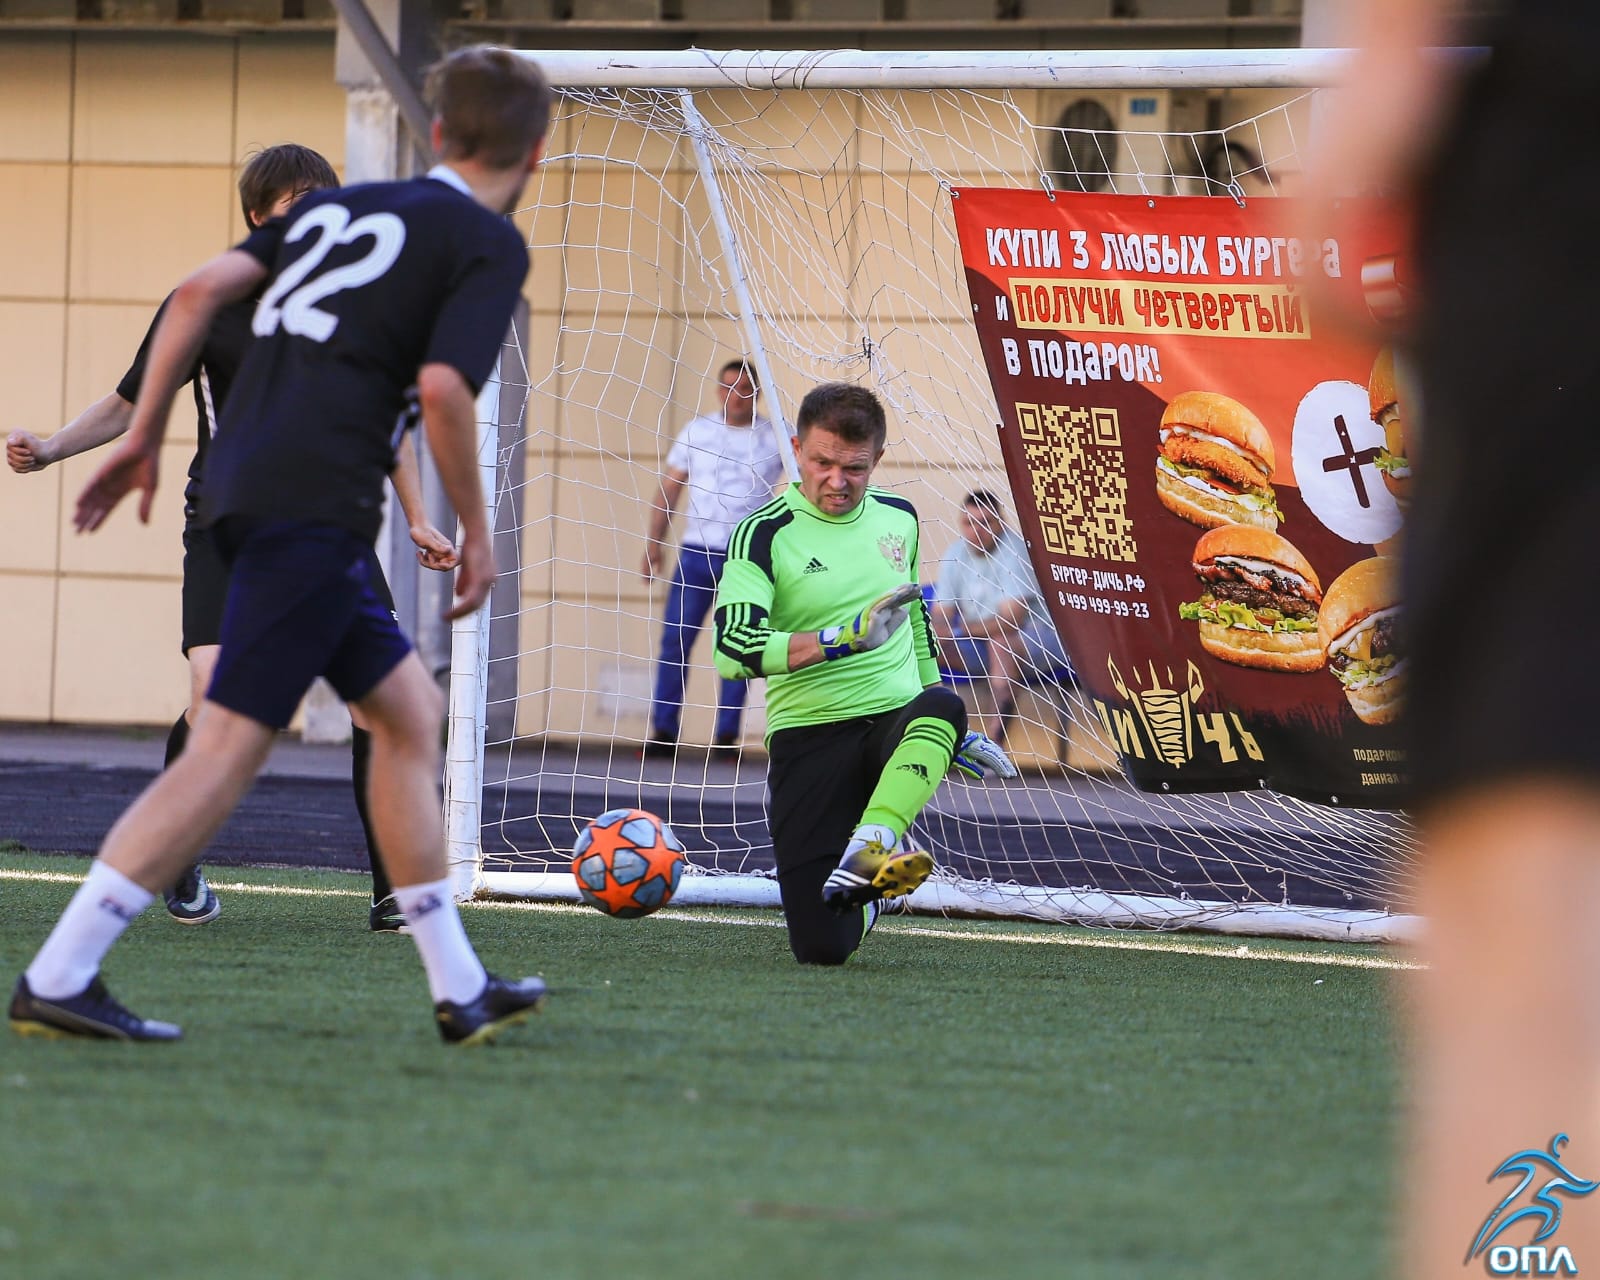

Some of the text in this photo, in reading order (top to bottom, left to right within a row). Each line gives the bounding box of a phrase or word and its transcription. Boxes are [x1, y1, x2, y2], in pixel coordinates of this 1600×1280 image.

[252, 203, 406, 343] 22
[985, 227, 1061, 269] КУПИ
[1069, 230, 1090, 269] 3
[1101, 232, 1209, 276] ЛЮБЫХ
[1014, 284, 1125, 326] ПОЛУЧИ
[1001, 338, 1163, 386] В ПОДАРОК!
[1058, 590, 1150, 619] 8 499 499-99-23
